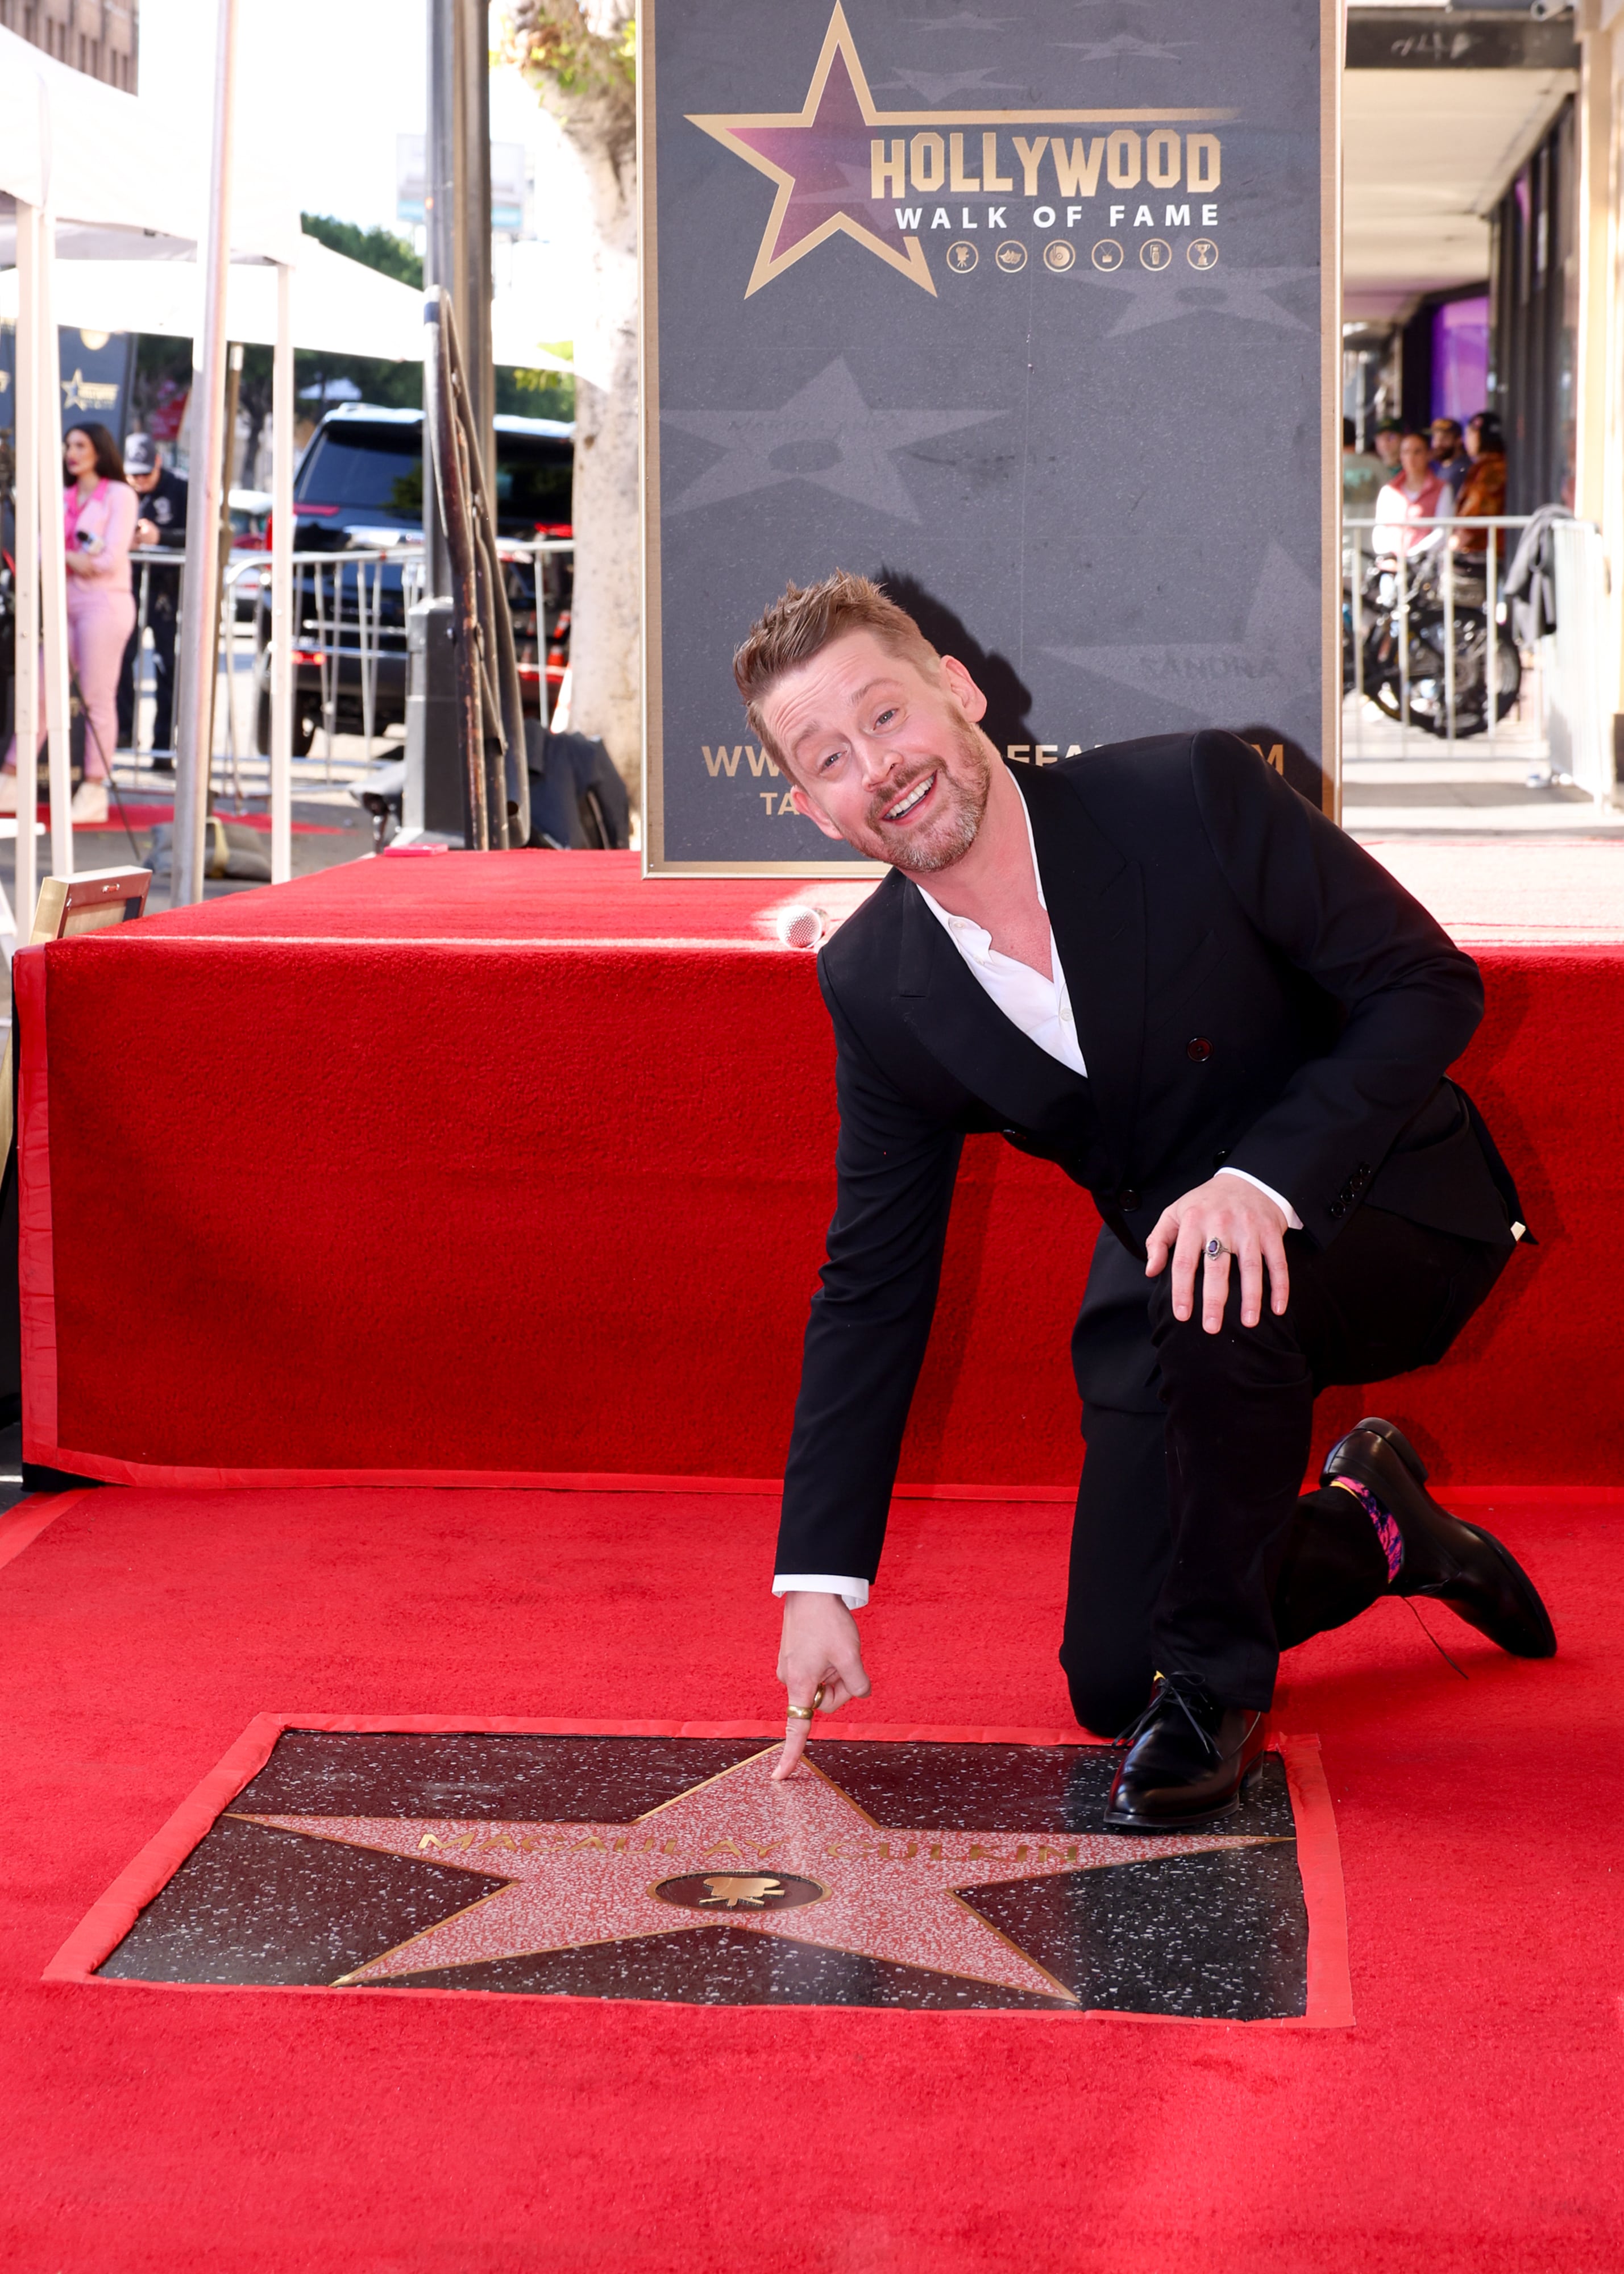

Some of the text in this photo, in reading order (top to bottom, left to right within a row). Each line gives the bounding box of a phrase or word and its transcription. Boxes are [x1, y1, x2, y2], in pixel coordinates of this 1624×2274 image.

[871, 129, 1221, 198] HOLLYWOOD
[894, 204, 1218, 229] WALK OF FAME
[417, 1833, 1077, 1863] MACAULAY CULKIN
